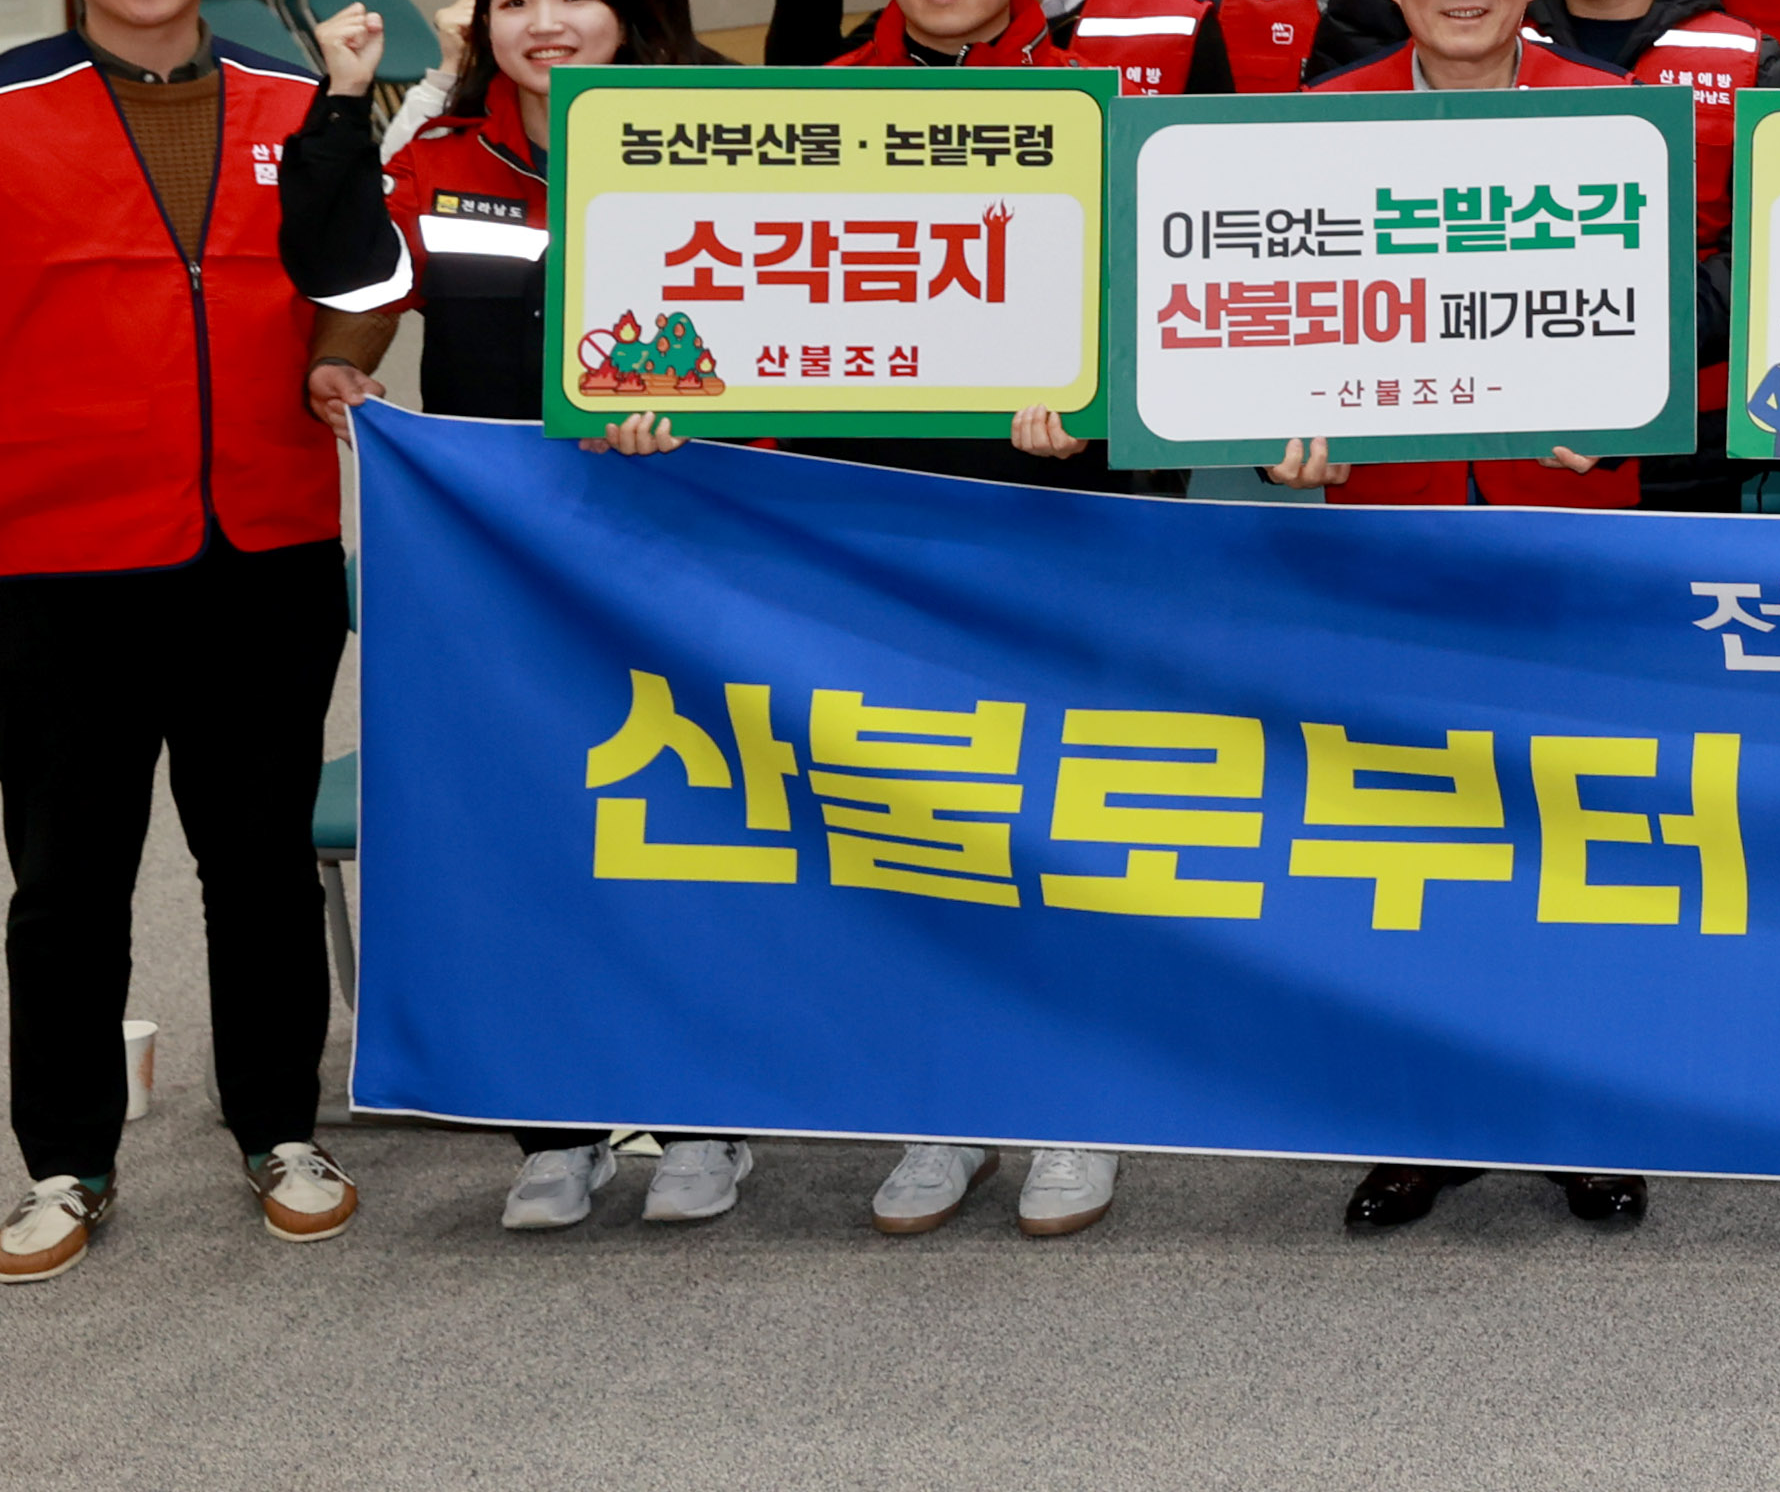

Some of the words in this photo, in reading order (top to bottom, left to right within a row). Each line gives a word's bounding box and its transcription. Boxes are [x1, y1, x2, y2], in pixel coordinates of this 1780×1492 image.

[1126, 66, 1162, 84] 예방
[1659, 69, 1732, 88] 산불예방
[1693, 90, 1731, 106] 라남도
[620, 122, 842, 167] 농산부산물
[884, 123, 1055, 167] 논밭두렁
[461, 199, 523, 218] 전라남도
[1162, 207, 1364, 260] 이득없는
[1373, 181, 1648, 256] 논밭소각
[661, 216, 1008, 304] 소각금지
[1156, 277, 1428, 350] 산불되어
[1439, 286, 1636, 340] 폐가망신
[755, 344, 920, 378] 산불조심
[586, 670, 1748, 934] 산불로부터
